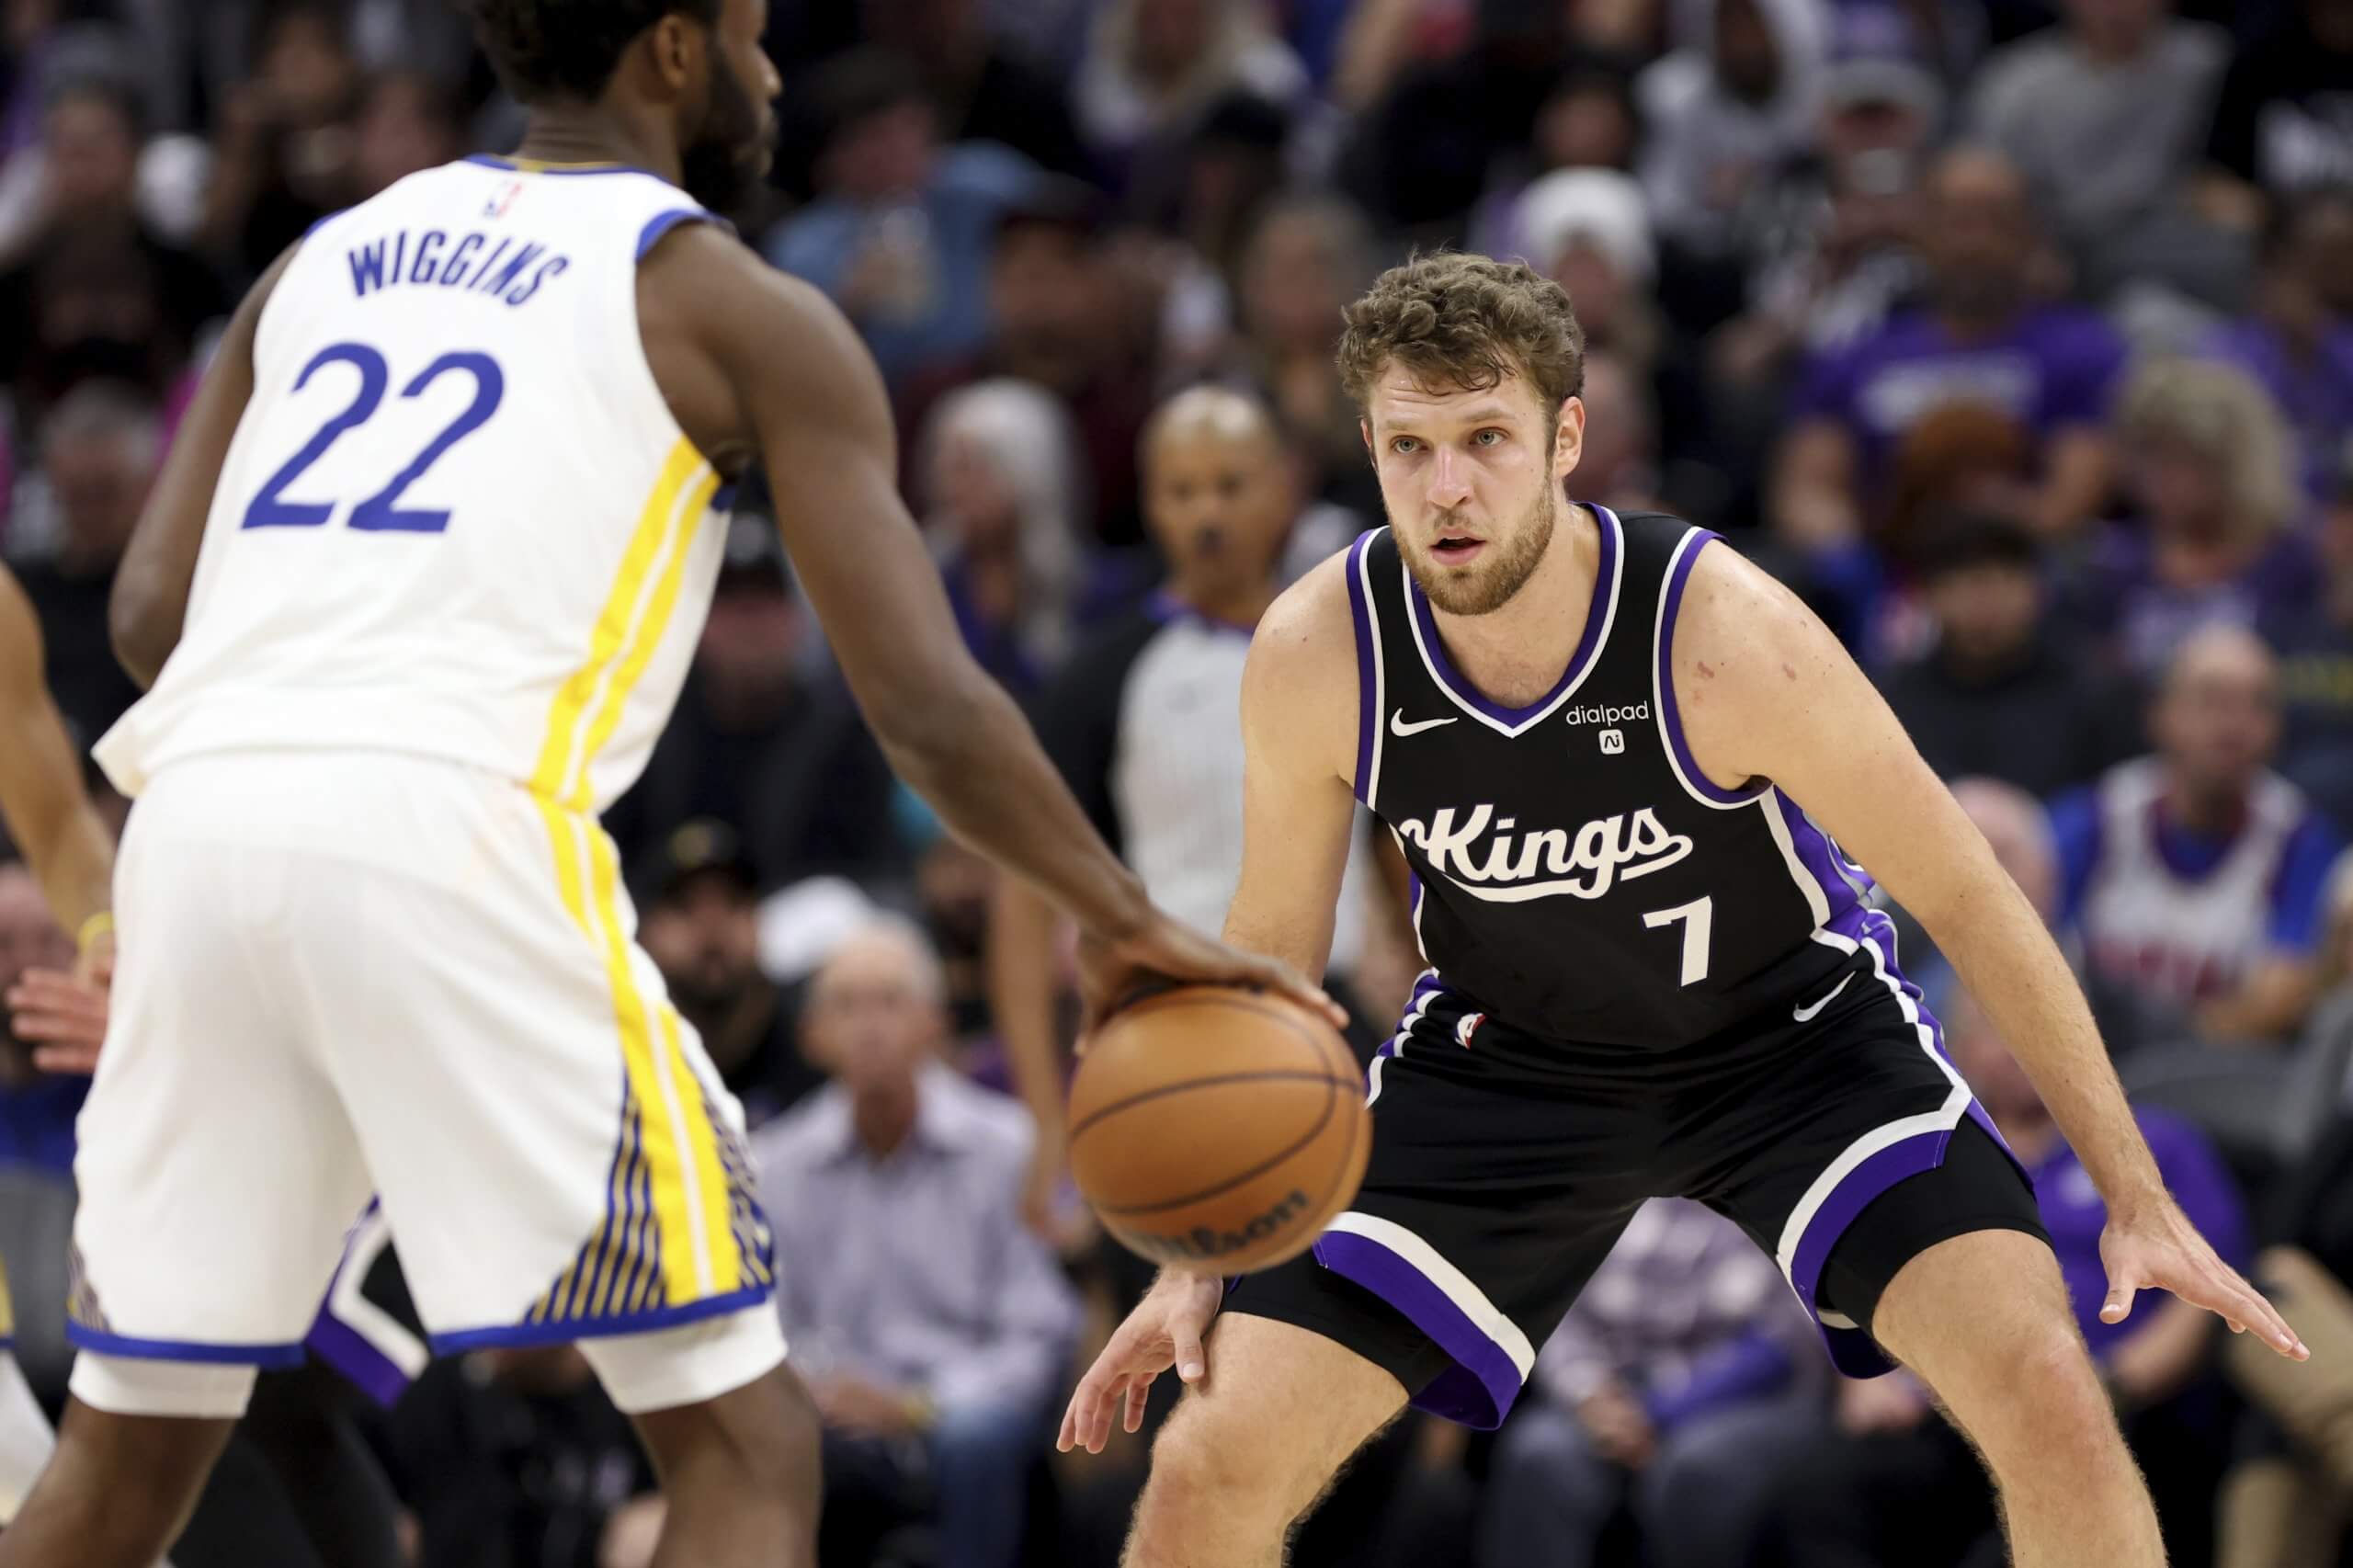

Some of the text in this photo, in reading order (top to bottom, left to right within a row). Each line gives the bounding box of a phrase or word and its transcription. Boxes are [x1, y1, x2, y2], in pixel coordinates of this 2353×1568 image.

[347, 229, 570, 308] WIGGINS
[241, 341, 504, 532] 22
[1565, 699, 1650, 727] dialpad
[1399, 803, 1693, 903] Kings
[1643, 895, 1711, 987] 7
